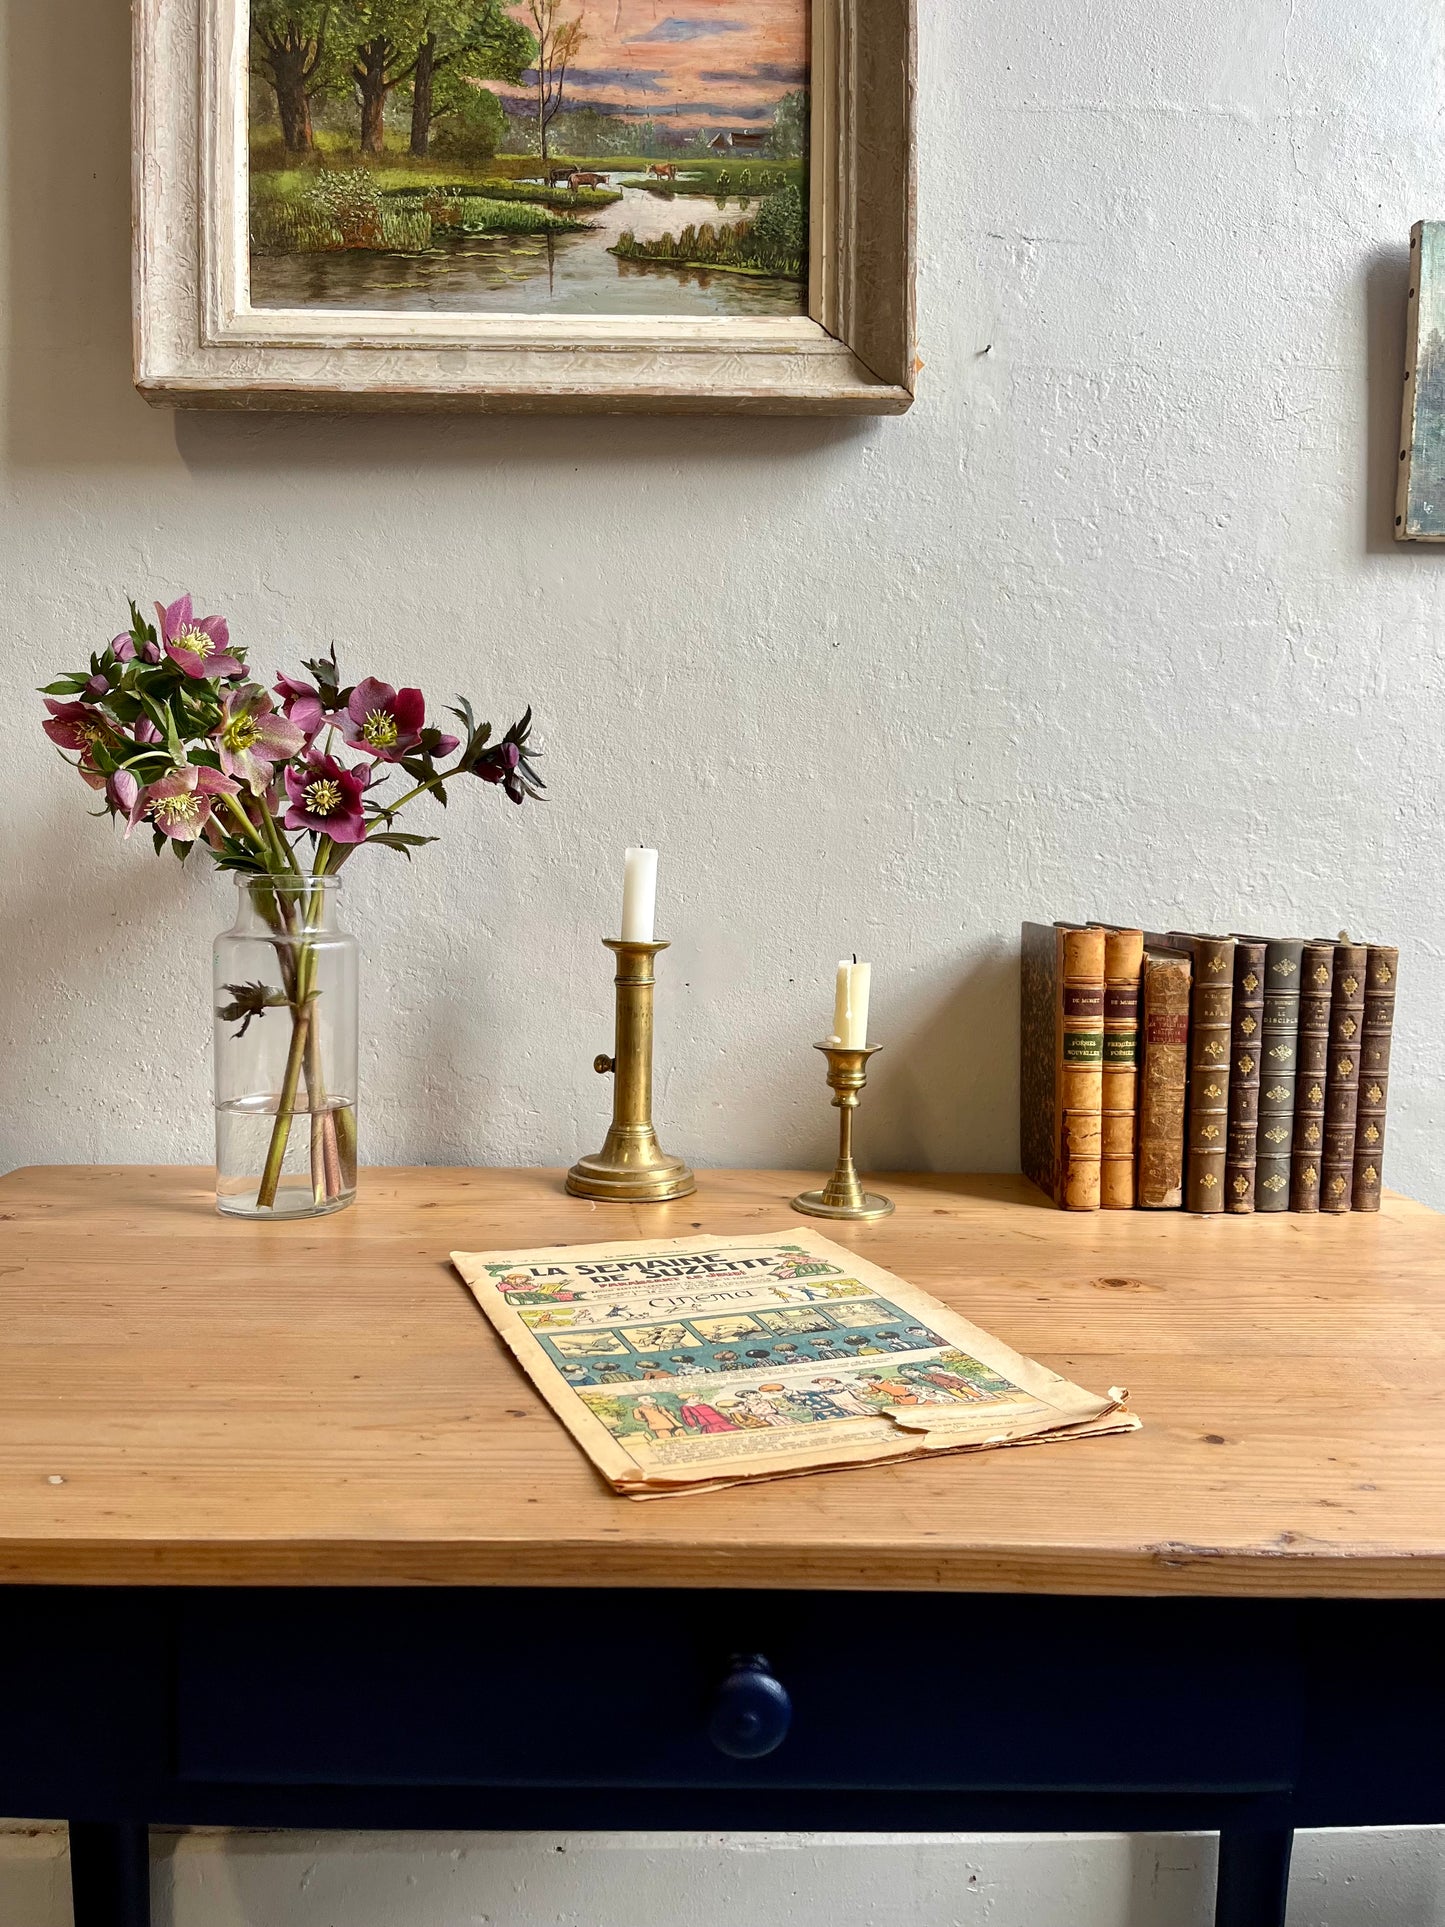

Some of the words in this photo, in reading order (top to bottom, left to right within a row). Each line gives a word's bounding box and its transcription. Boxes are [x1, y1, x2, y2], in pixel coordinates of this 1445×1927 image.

[529, 1267, 569, 1278] LA
[575, 1253, 728, 1276] SEMAINE
[590, 1273, 630, 1284] DE
[639, 1256, 780, 1279] SUZETTE
